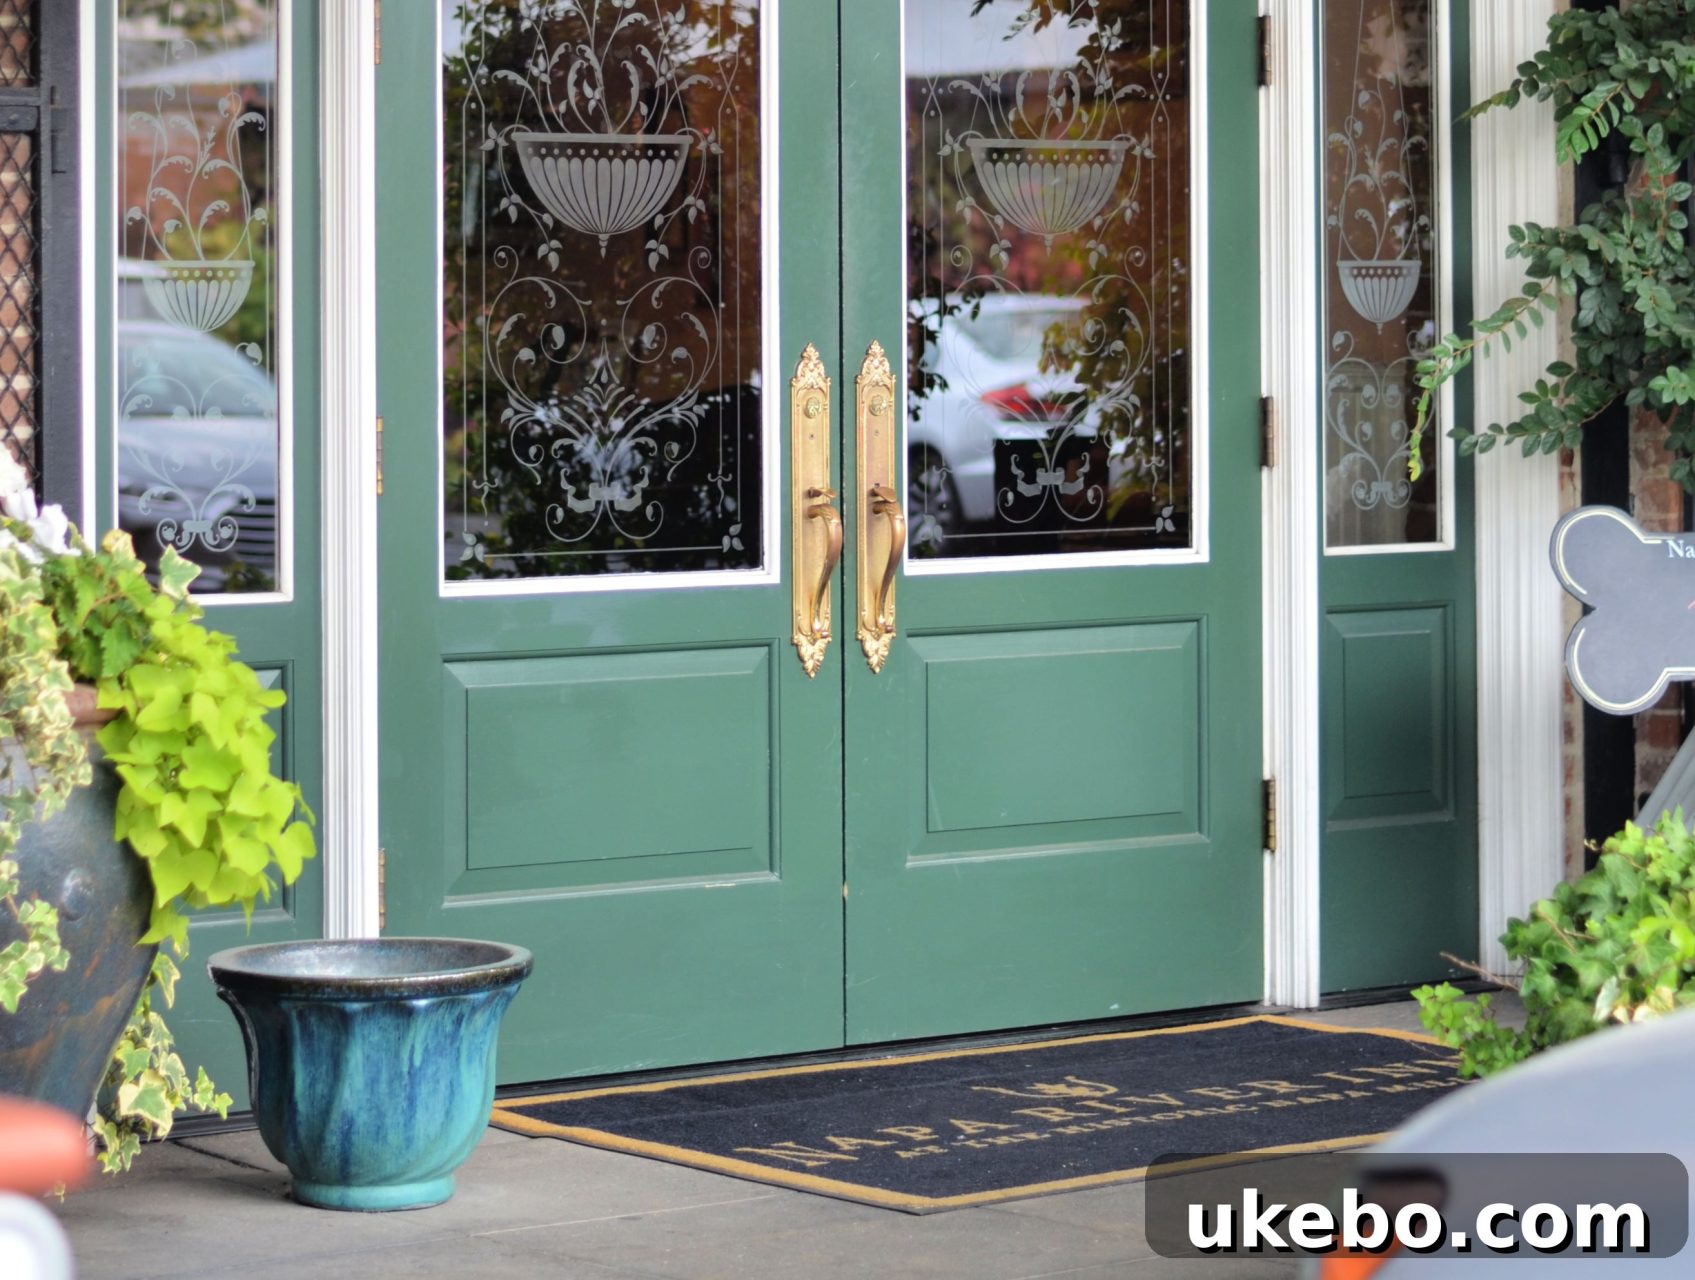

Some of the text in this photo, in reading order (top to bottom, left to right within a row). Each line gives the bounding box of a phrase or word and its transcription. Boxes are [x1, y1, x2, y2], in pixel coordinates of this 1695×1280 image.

[732, 1119, 1021, 1167] NAPA
[1011, 1080, 1326, 1122] RIVER
[1049, 1103, 1259, 1134] HISTORIC
